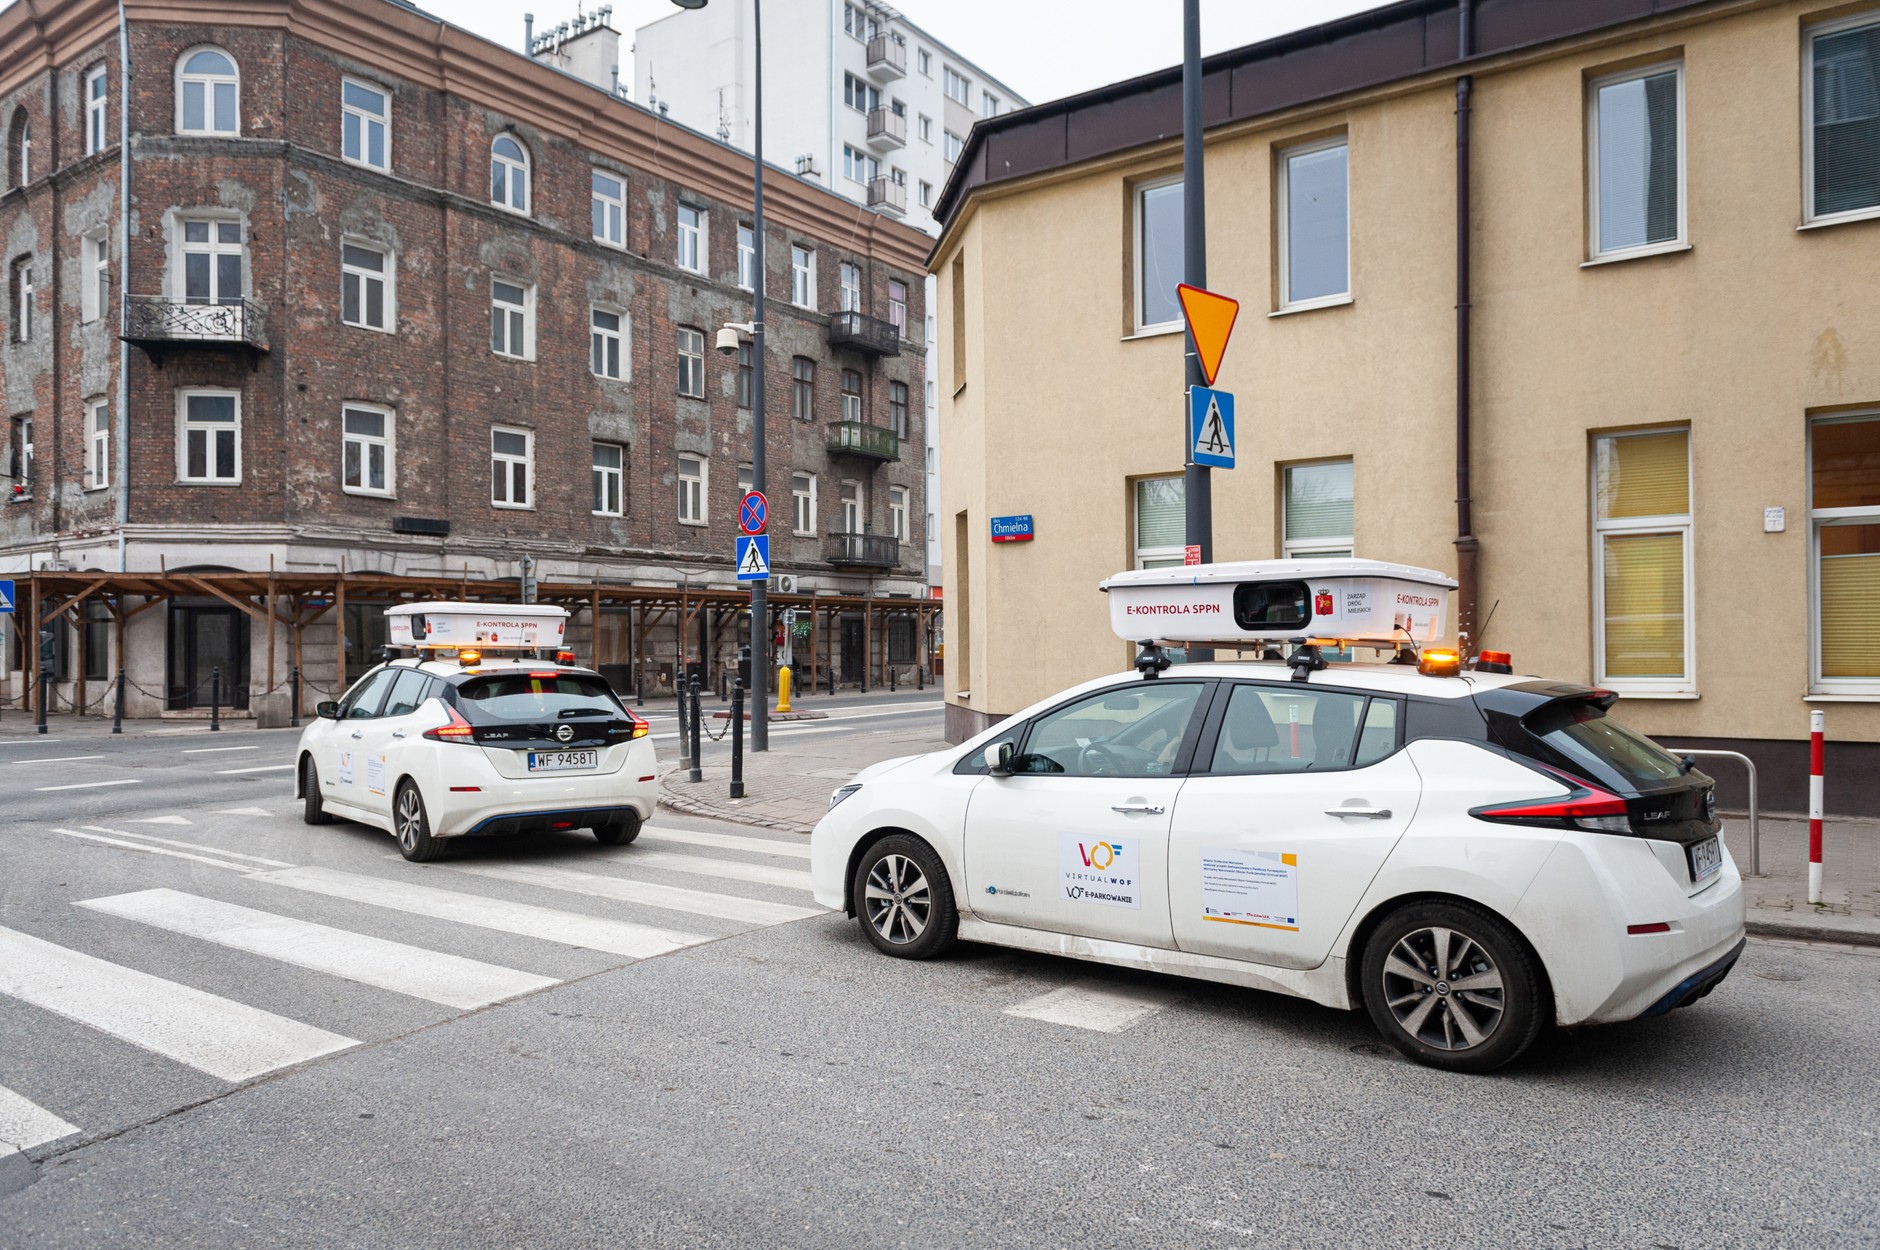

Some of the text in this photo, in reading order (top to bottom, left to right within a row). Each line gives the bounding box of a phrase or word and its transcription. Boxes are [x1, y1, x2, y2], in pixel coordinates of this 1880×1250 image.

[994, 522, 1028, 533] Chmielna
[1397, 593, 1439, 607] E-KONTROLA SPPN
[1127, 604, 1220, 615] E-KONTROLA SPPN
[538, 752, 594, 767] WF 9458T
[1644, 810, 1671, 820] LEAF
[1085, 890, 1132, 903] E-PARKOWANIE
